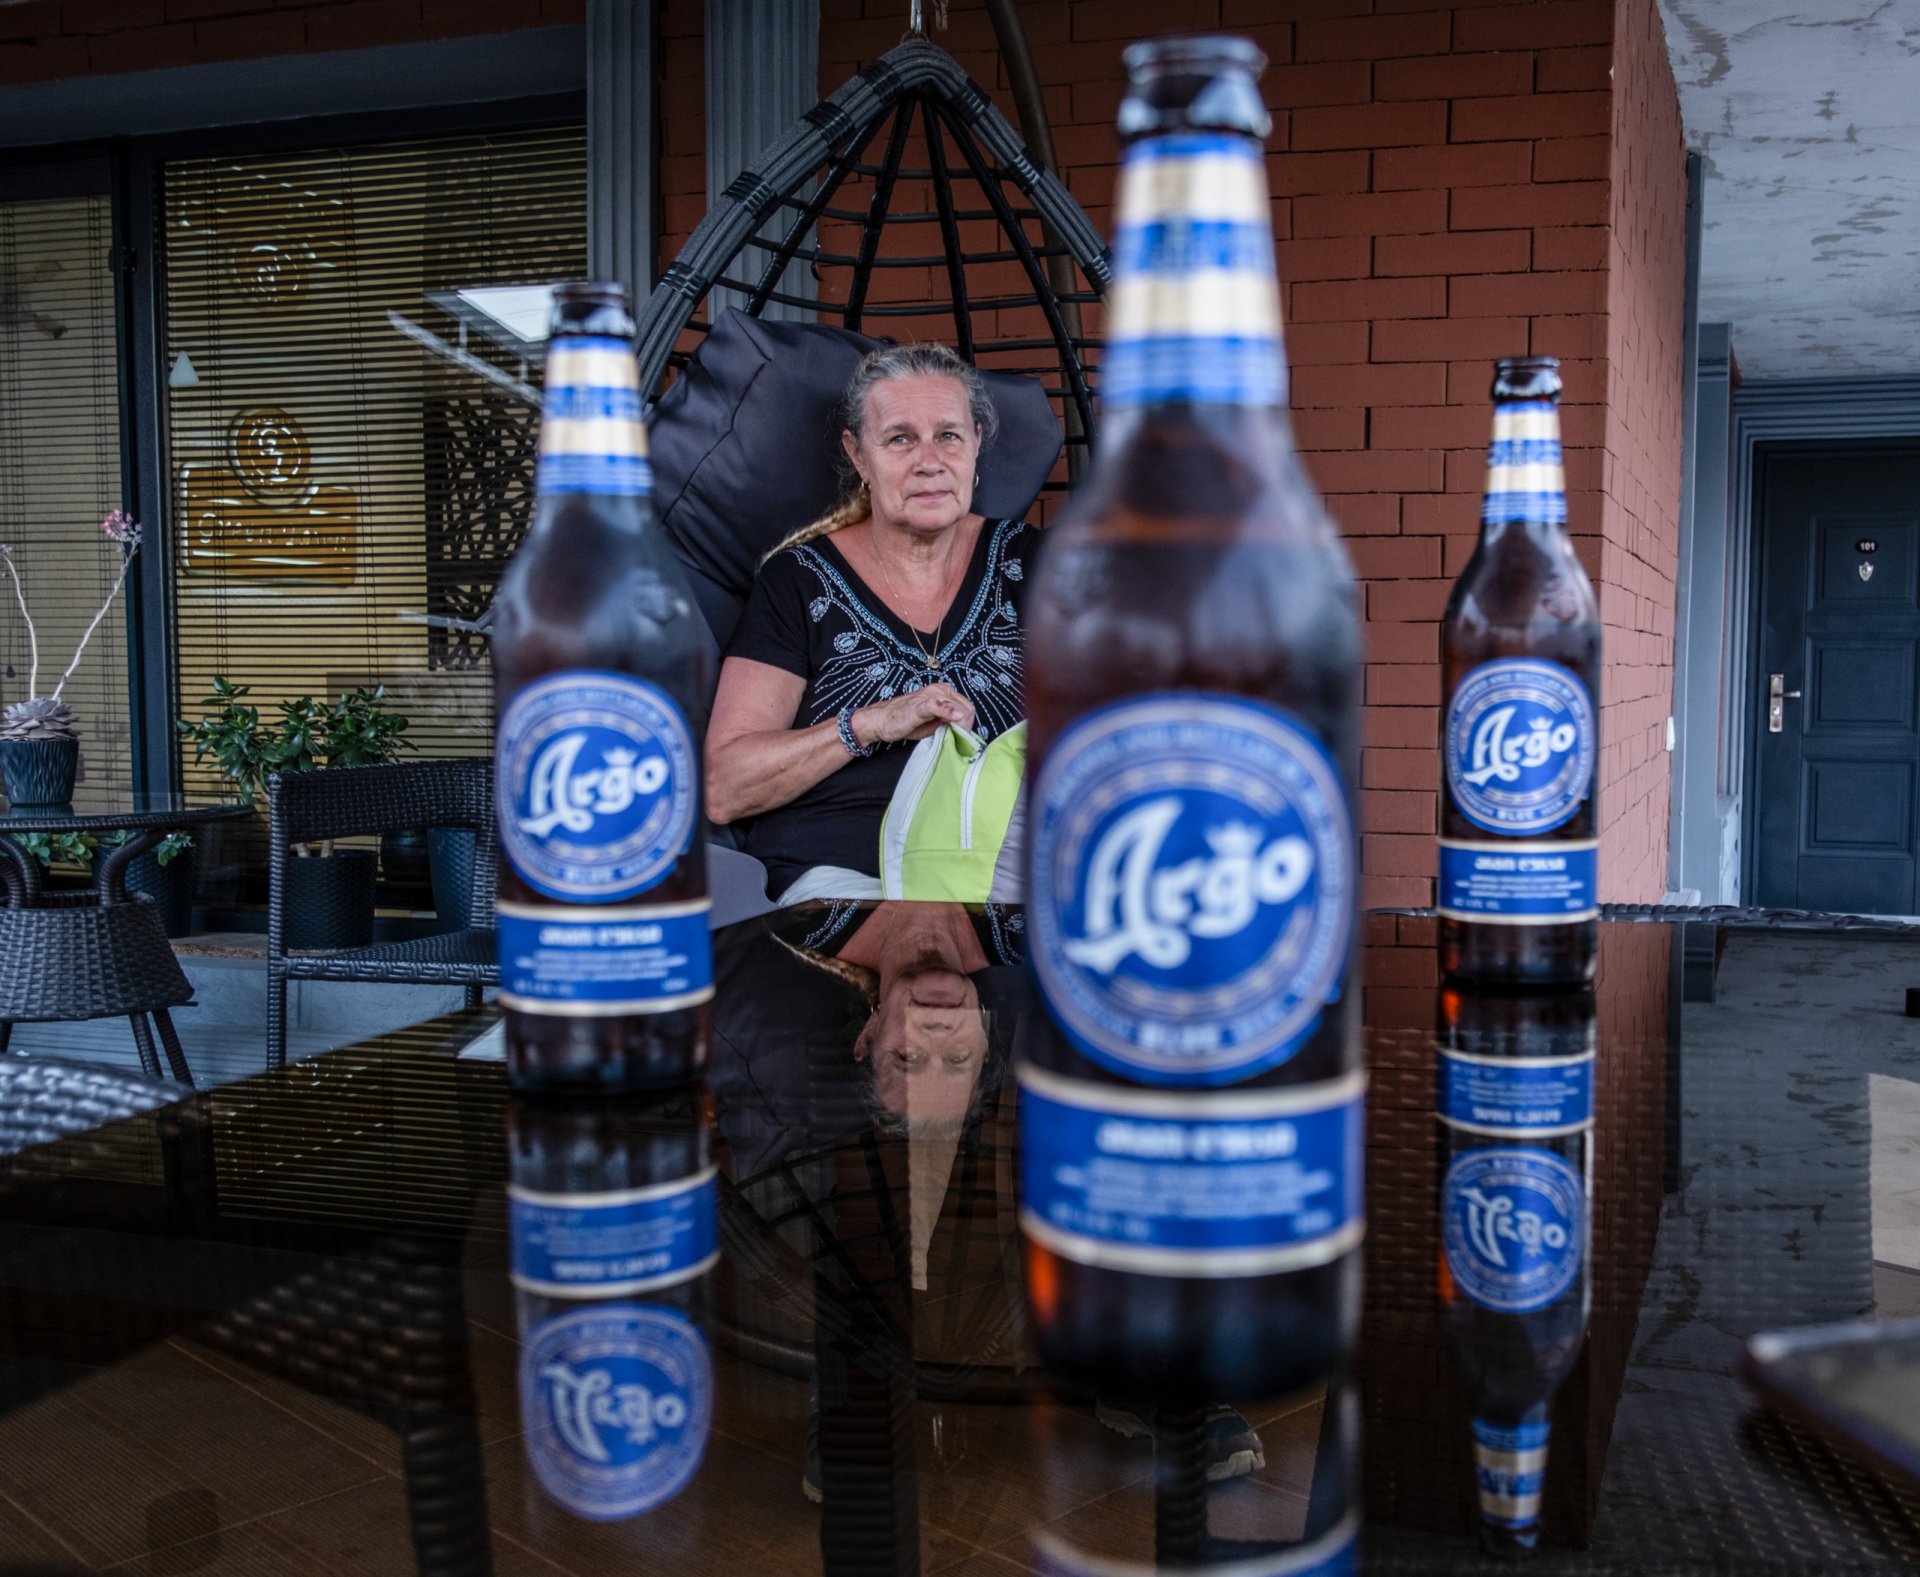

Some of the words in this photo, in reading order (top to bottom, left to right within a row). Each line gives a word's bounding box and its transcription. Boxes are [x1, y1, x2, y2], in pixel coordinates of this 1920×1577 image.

[1860, 541, 1875, 551] 101
[517, 731, 670, 839] Argo
[1463, 706, 1577, 787] Argo
[1062, 796, 1315, 976] Argo
